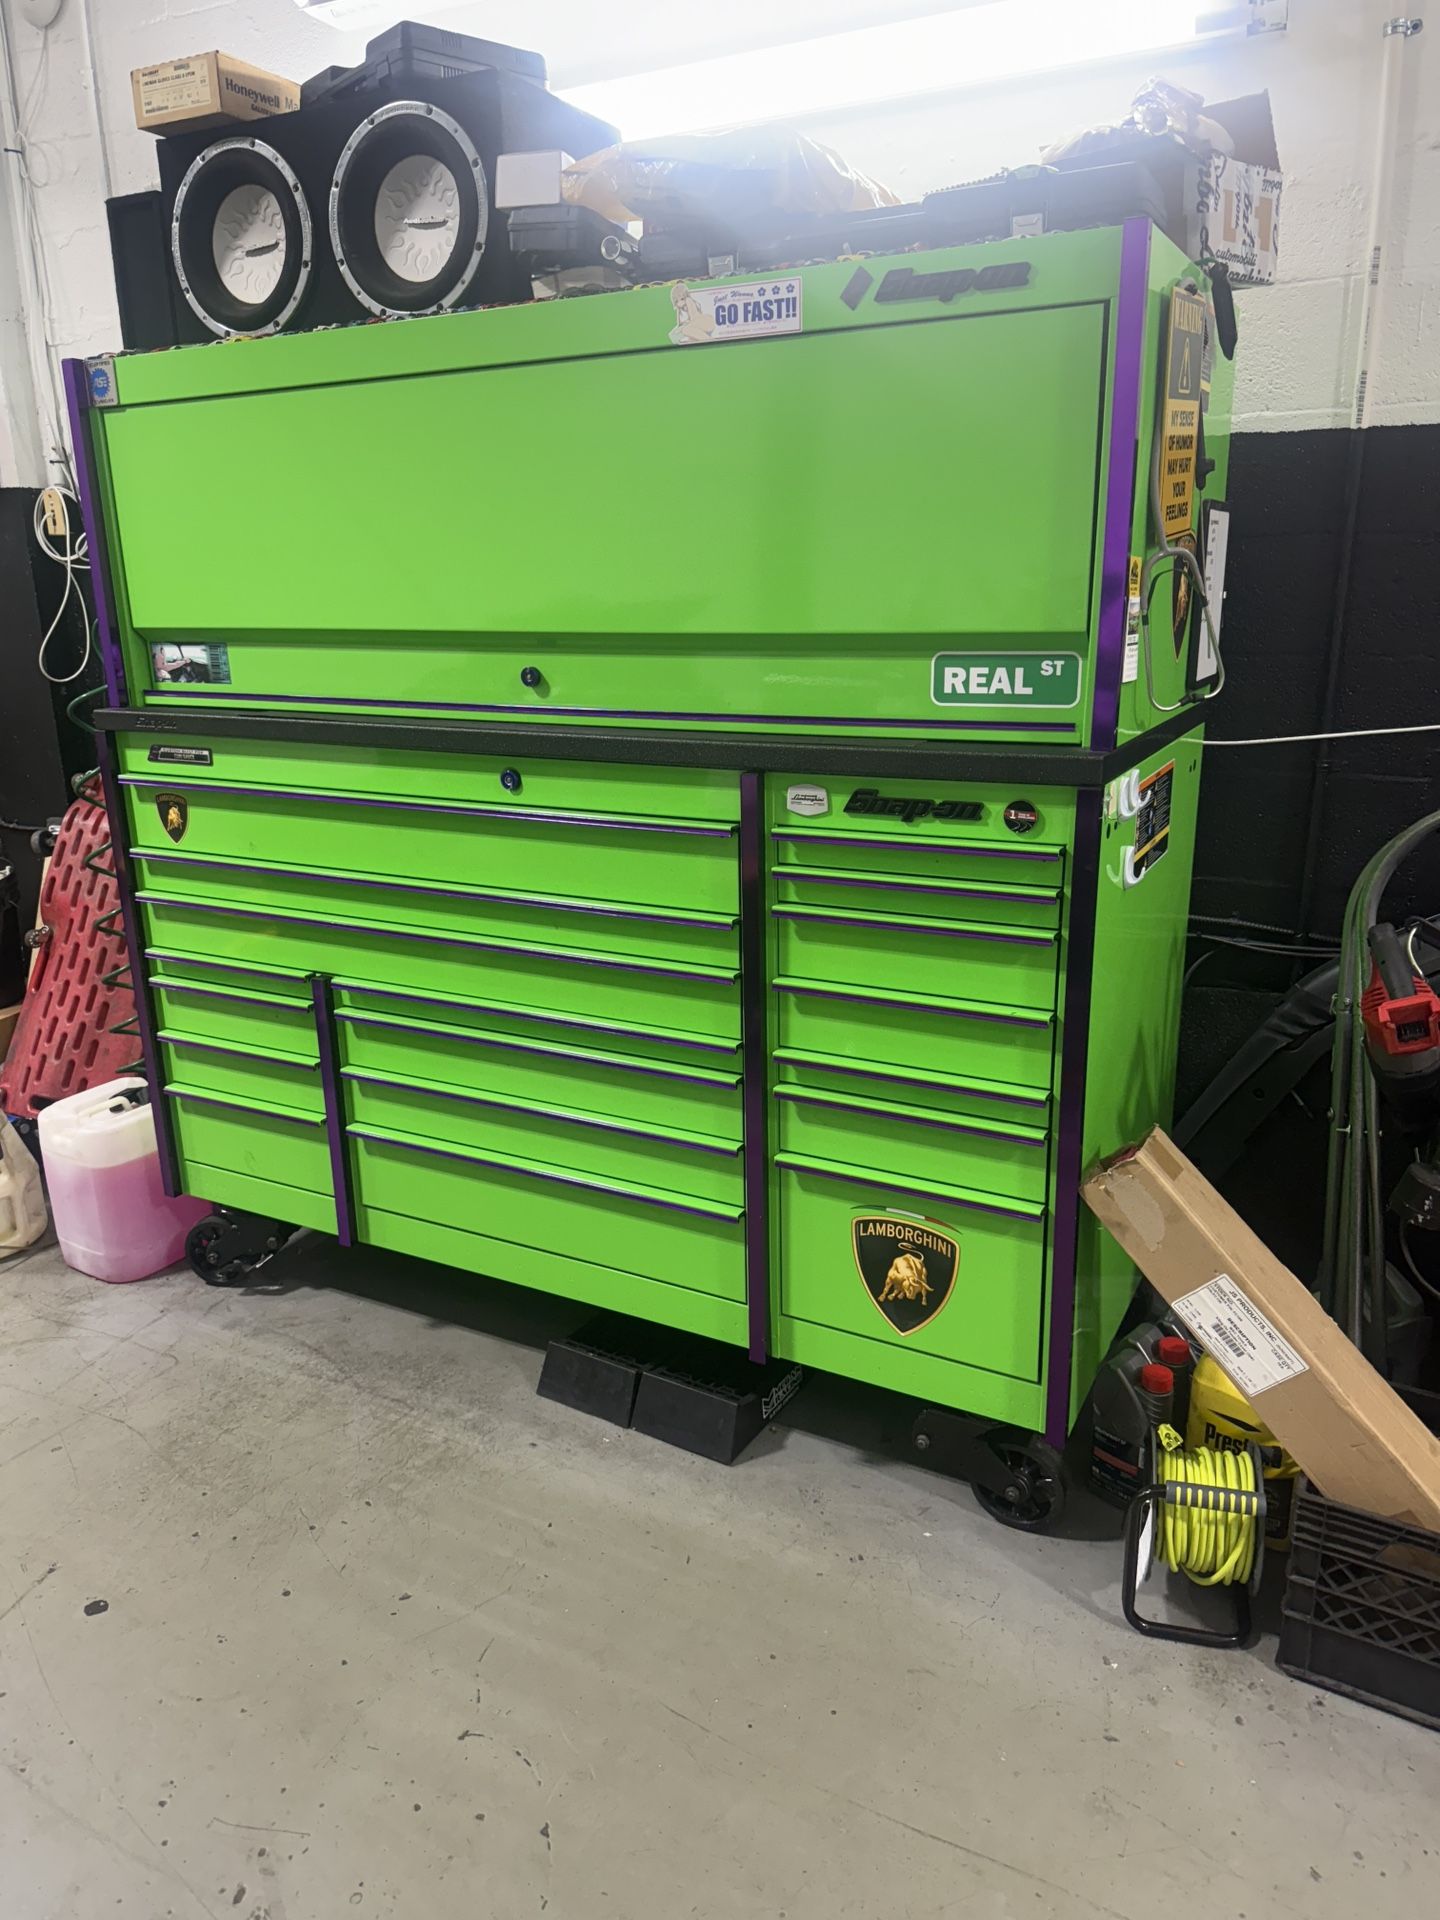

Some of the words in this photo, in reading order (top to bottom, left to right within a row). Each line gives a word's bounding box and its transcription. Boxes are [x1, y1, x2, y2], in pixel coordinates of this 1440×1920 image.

[225, 77, 280, 109] Honeywell
[715, 303, 739, 326] GO
[743, 296, 797, 323] FAST!!
[1174, 297, 1204, 335] WARNING
[1171, 410, 1179, 427] MY
[1180, 410, 1194, 427] SENSE
[1168, 434, 1176, 451] OF
[1176, 434, 1193, 450] HUMOR
[1167, 458, 1177, 476] MAY
[1178, 456, 1192, 474] HURT
[1172, 481, 1186, 498] YOUR
[1165, 501, 1188, 522] FEELINGS
[943, 667, 1033, 695] REAL
[1040, 660, 1065, 676] ST
[843, 788, 985, 823] Snap-on
[1009, 810, 1016, 819] 1
[860, 1222, 952, 1258] LAMBORGHINI
[1229, 1290, 1238, 1299] JS
[1227, 1317, 1256, 1350] DESCRIPTION
[1204, 1422, 1249, 1456] Prest
